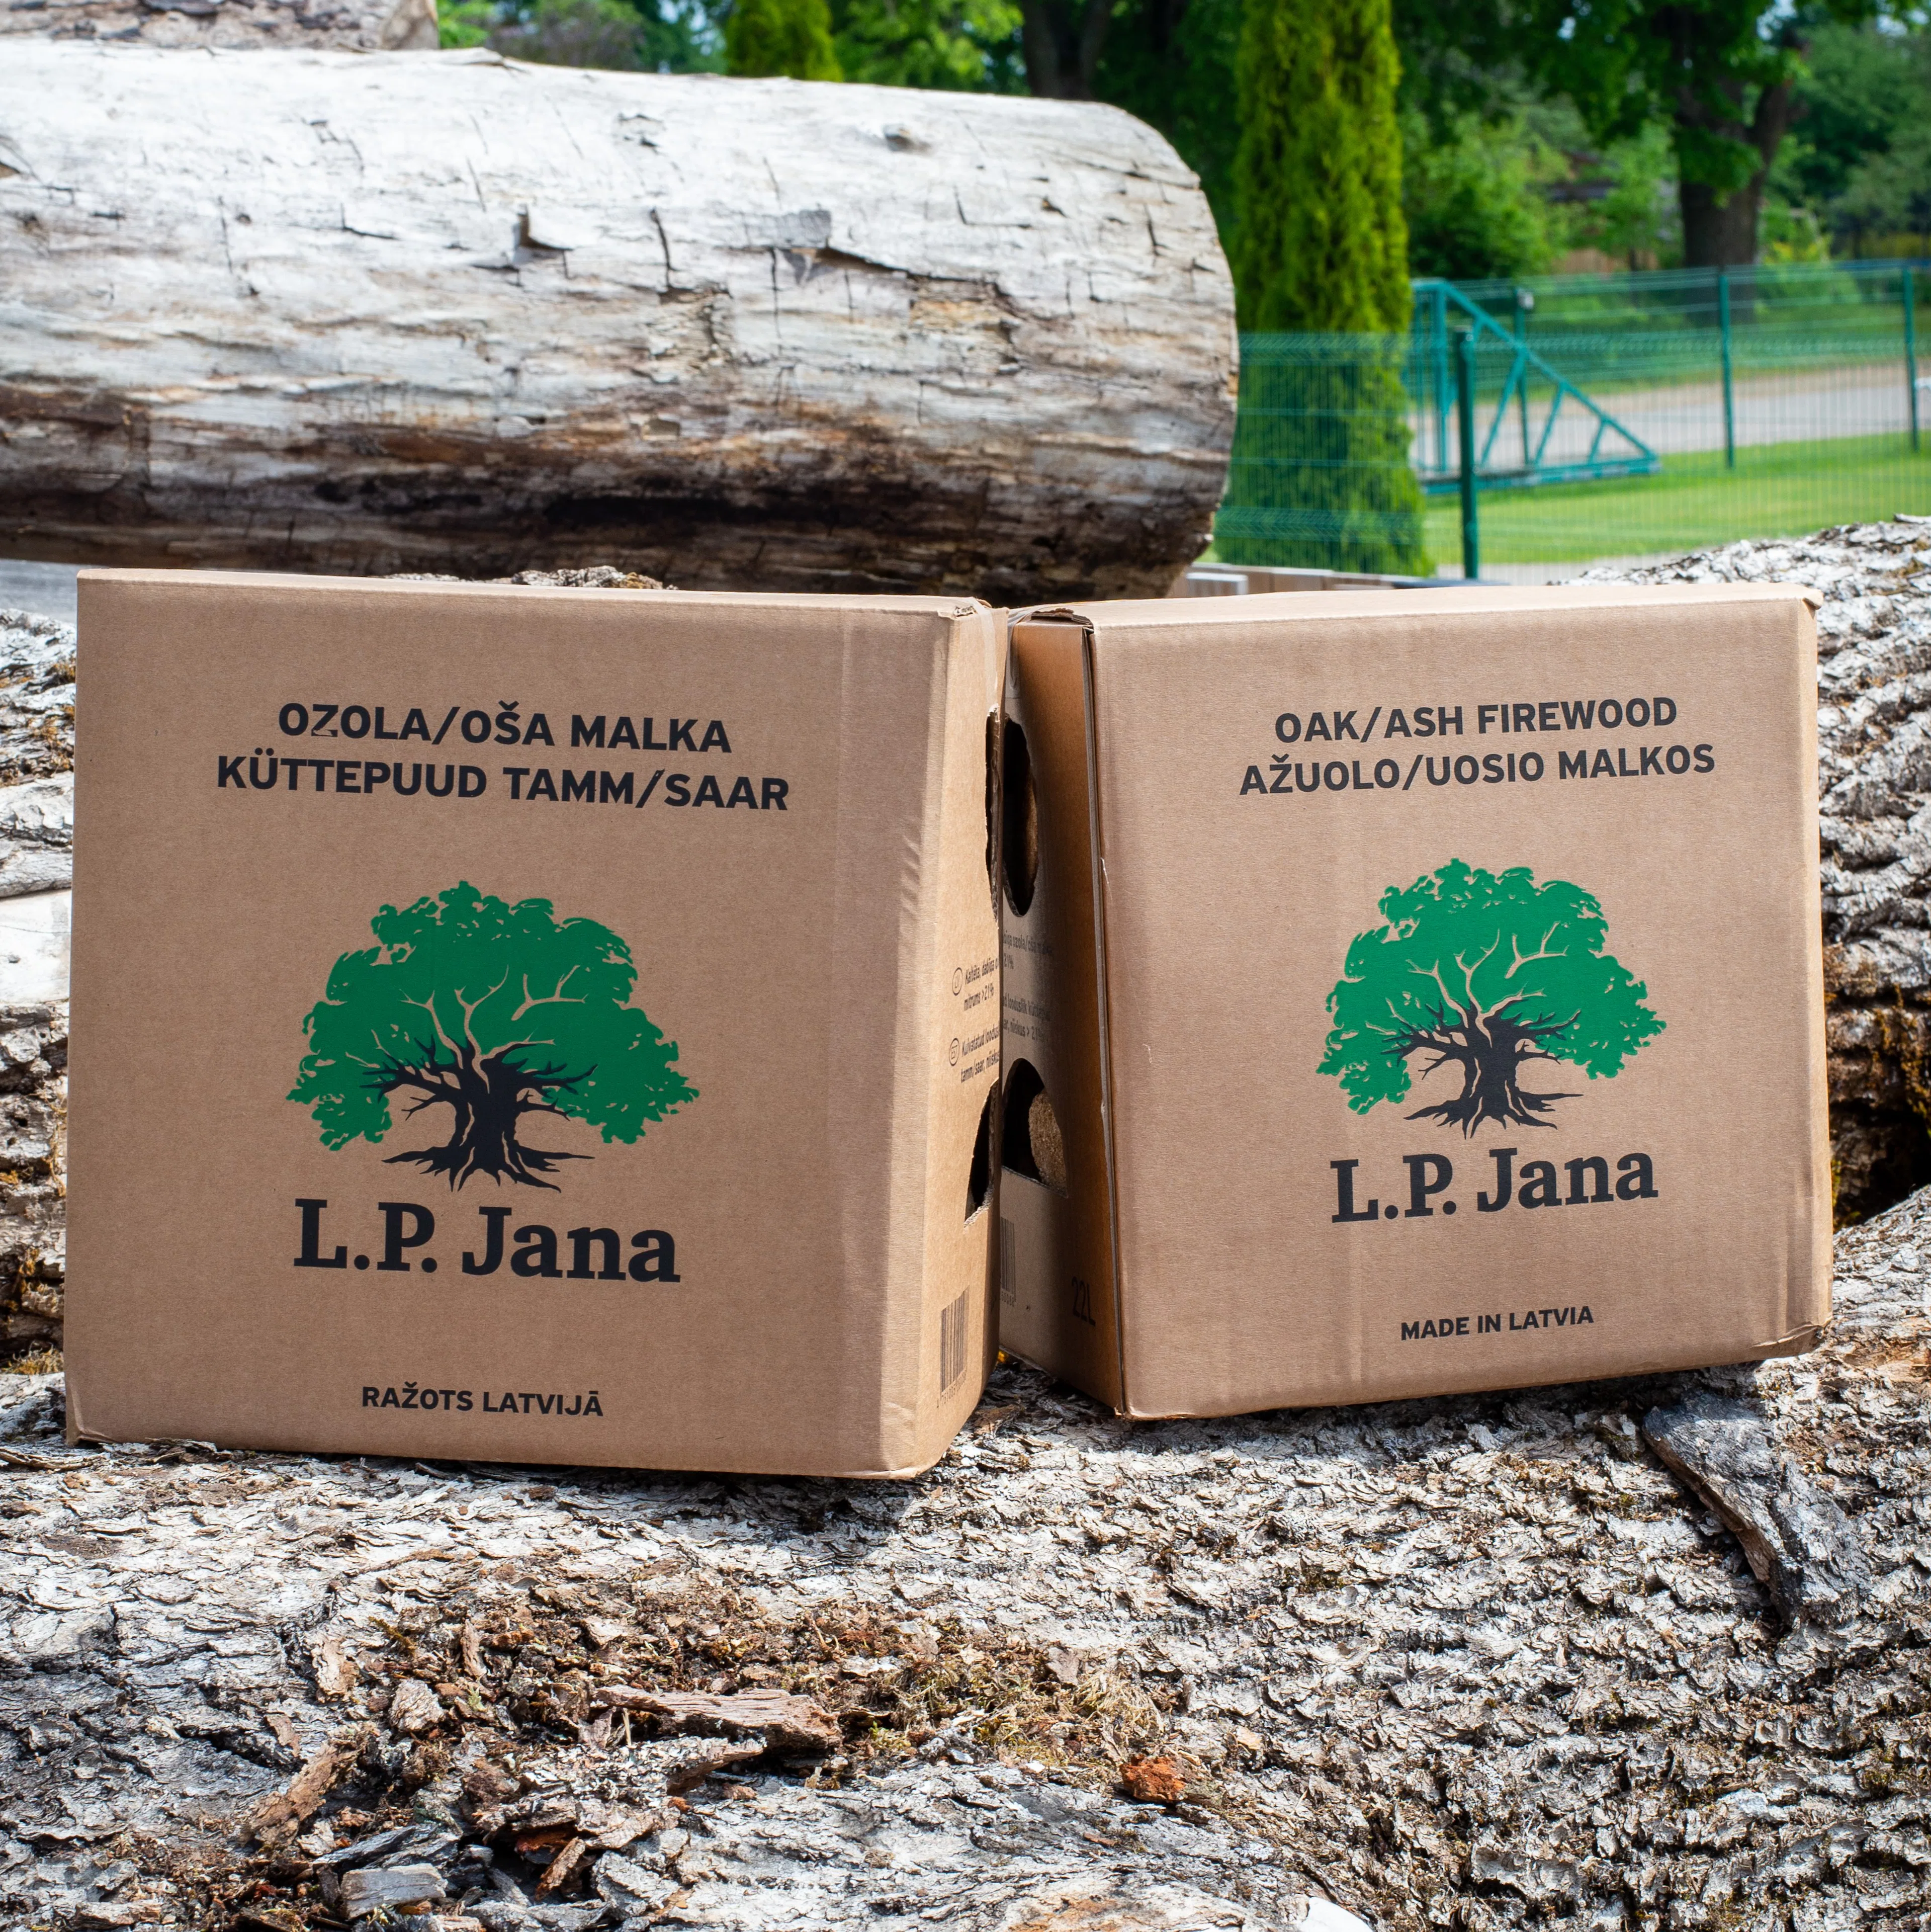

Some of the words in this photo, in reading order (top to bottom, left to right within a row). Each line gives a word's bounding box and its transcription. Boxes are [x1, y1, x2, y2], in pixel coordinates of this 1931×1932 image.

[279, 700, 556, 746] OZOLA/OŠA
[571, 714, 732, 753] MALKA
[1276, 706, 1463, 743] OAK/ASH
[1477, 697, 1677, 734] FIREWOOD
[218, 747, 487, 800] KÜTTEPUUD
[503, 767, 789, 811] TAMM/SAAR
[1240, 753, 1544, 795] AŽUOLO/UOSIO
[1558, 744, 1715, 780] MALKOS
[1330, 1153, 1457, 1223] L.P.
[1477, 1147, 1658, 1213] Jana
[294, 1198, 438, 1274] L.P.
[462, 1205, 681, 1283] Jana
[1401, 1317, 1470, 1341] MADE
[1477, 1314, 1501, 1334] IN
[1509, 1306, 1594, 1331] LATVIA
[362, 1381, 474, 1411] RAŽOTS
[483, 1390, 604, 1417] LATVIJĀ
